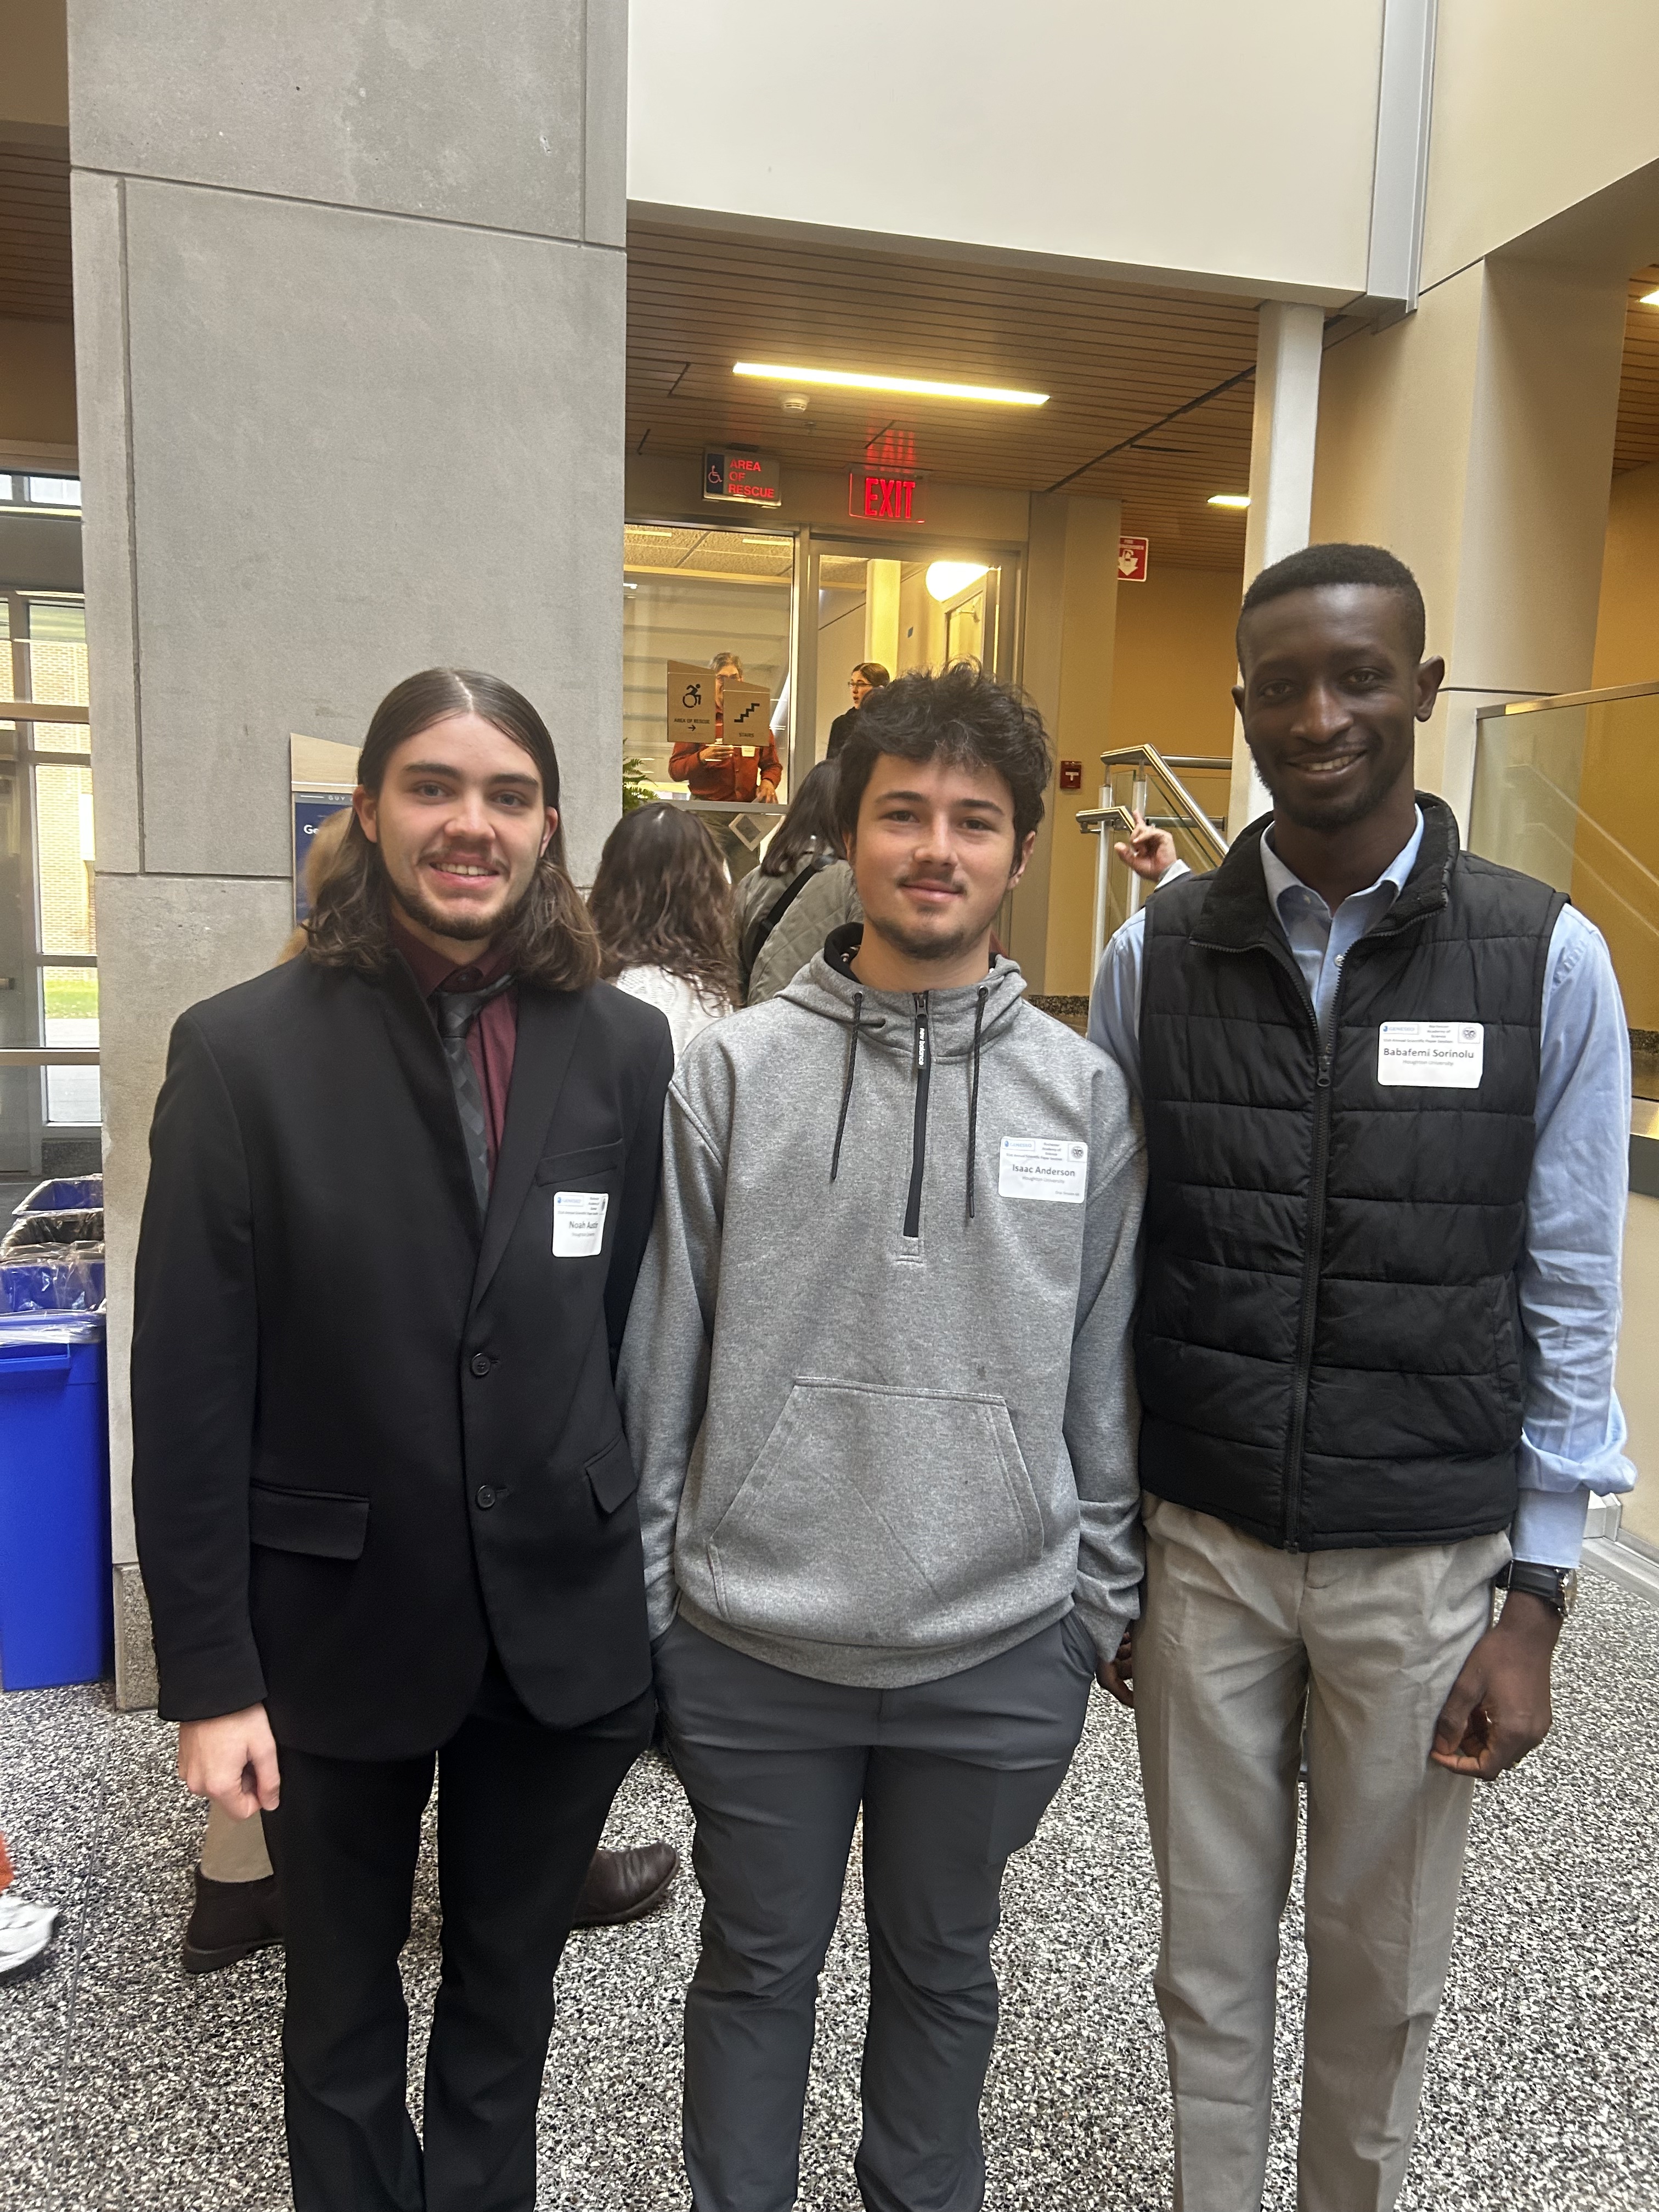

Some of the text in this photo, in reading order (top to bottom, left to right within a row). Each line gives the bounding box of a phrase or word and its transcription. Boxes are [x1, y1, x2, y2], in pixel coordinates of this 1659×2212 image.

[730, 459, 761, 472] AREA
[729, 471, 746, 482] OF
[728, 483, 775, 498] RESCUE
[865, 477, 916, 519] EXIT
[1384, 1048, 1475, 1058] Babafemi Sorinolu
[1012, 1164, 1075, 1177] Isaac Anderson
